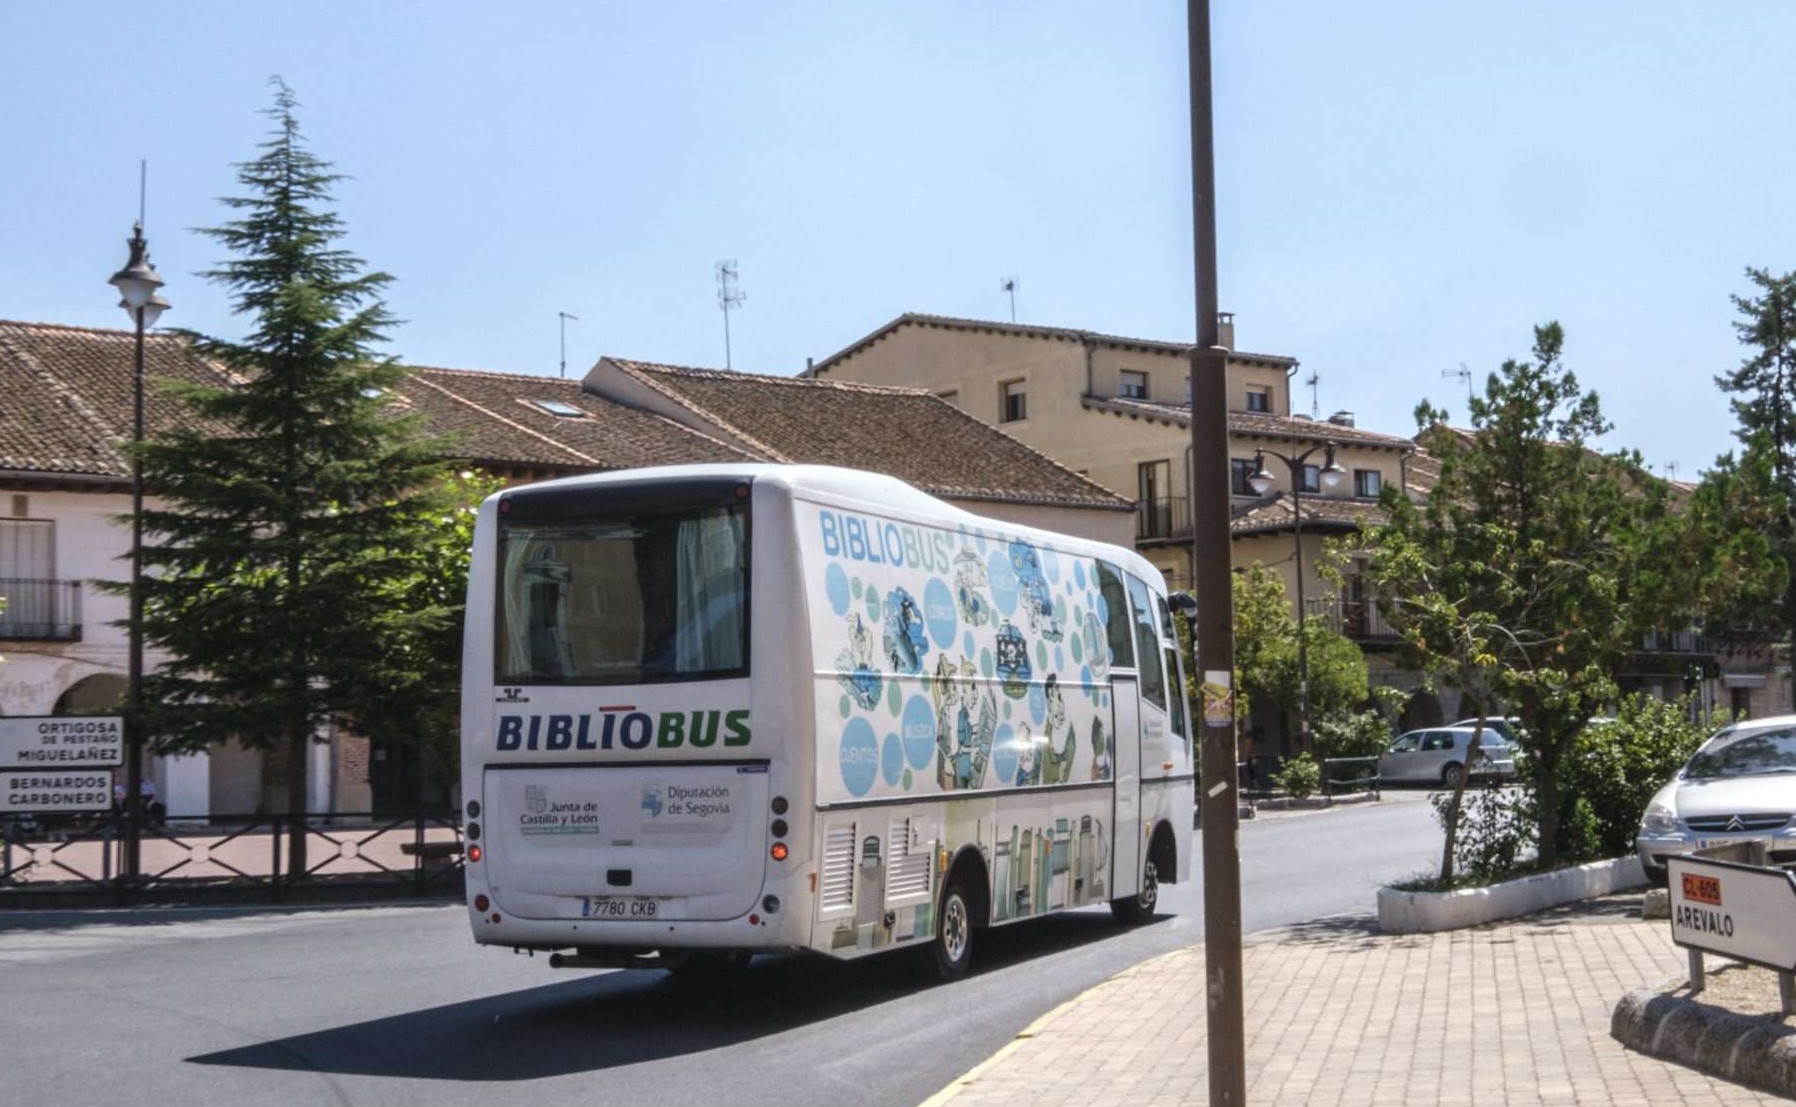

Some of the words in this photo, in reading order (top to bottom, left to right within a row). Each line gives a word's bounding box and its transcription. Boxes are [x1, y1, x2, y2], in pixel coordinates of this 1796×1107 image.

[819, 510, 950, 574] BIBLIOBUS
[38, 722, 118, 734] ORTIGOSA
[41, 735, 58, 745] DE
[63, 733, 119, 744] PESTAÑO
[18, 746, 118, 761] MIGUELAÑEZ
[10, 777, 107, 789] BERNARDOS
[9, 792, 107, 805] CARBONERO
[668, 785, 729, 800] Diputación
[550, 802, 580, 812] Junta
[583, 802, 598, 811] de
[668, 803, 683, 815] de
[686, 801, 730, 818] Segovia
[520, 814, 558, 825] Castilla
[561, 815, 568, 826] y
[571, 812, 598, 824] León
[1683, 876, 1720, 900] CL-605
[594, 901, 626, 915] 7780
[1676, 904, 1734, 938] AREVALO
